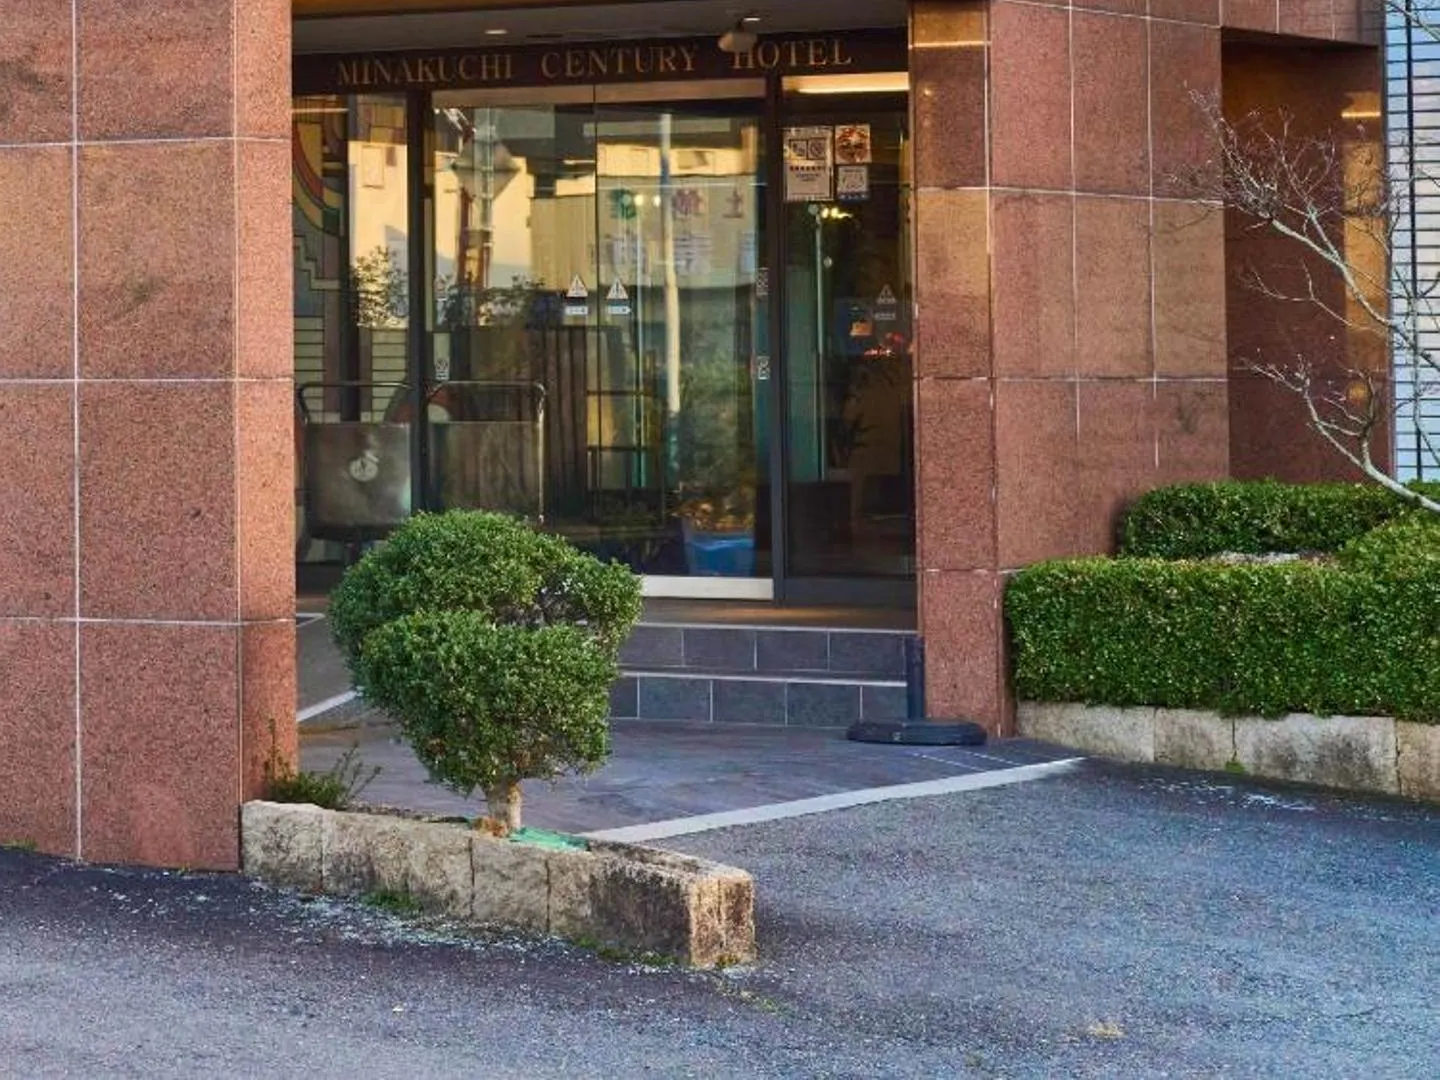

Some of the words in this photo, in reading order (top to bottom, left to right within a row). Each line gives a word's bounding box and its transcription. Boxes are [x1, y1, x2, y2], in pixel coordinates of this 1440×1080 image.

[338, 53, 513, 87] MINAKUCHI
[541, 45, 697, 78] CENTURY
[733, 38, 852, 70] HOTEL
